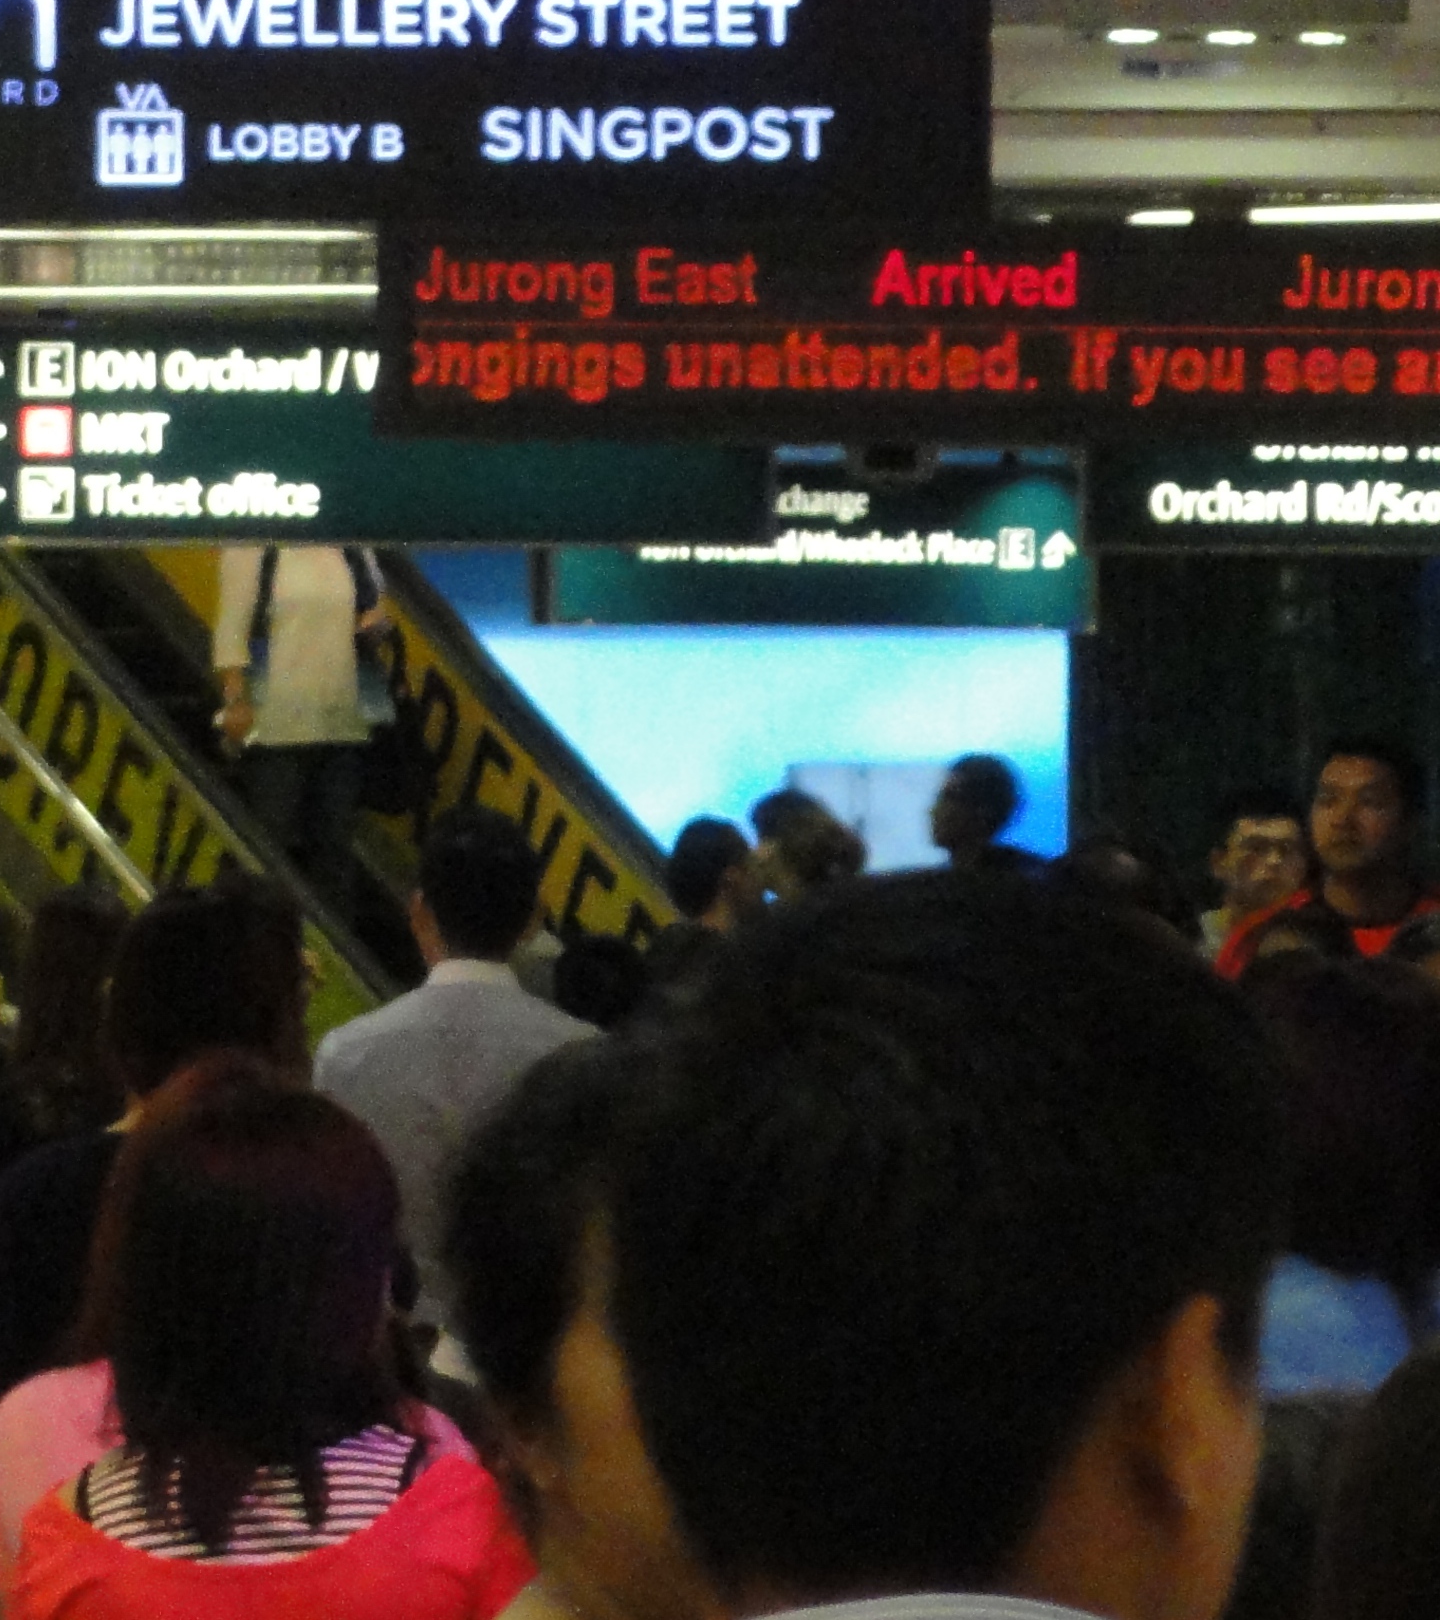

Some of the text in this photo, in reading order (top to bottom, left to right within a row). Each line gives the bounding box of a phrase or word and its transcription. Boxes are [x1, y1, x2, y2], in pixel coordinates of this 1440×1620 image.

[210, 108, 833, 161] LOBBY B SINGPOST
[416, 248, 613, 318] Jurong
[636, 248, 756, 304] East
[872, 250, 1077, 308] Arrived
[81, 350, 156, 391] ION
[162, 348, 321, 392] Orchard
[667, 332, 1037, 390] unattended.
[1072, 334, 1117, 389] If
[1131, 347, 1244, 406] you
[1265, 348, 1376, 393] see
[80, 411, 170, 454] MRT
[82, 472, 320, 517] Ticket office
[1150, 480, 1307, 522] Orchard
